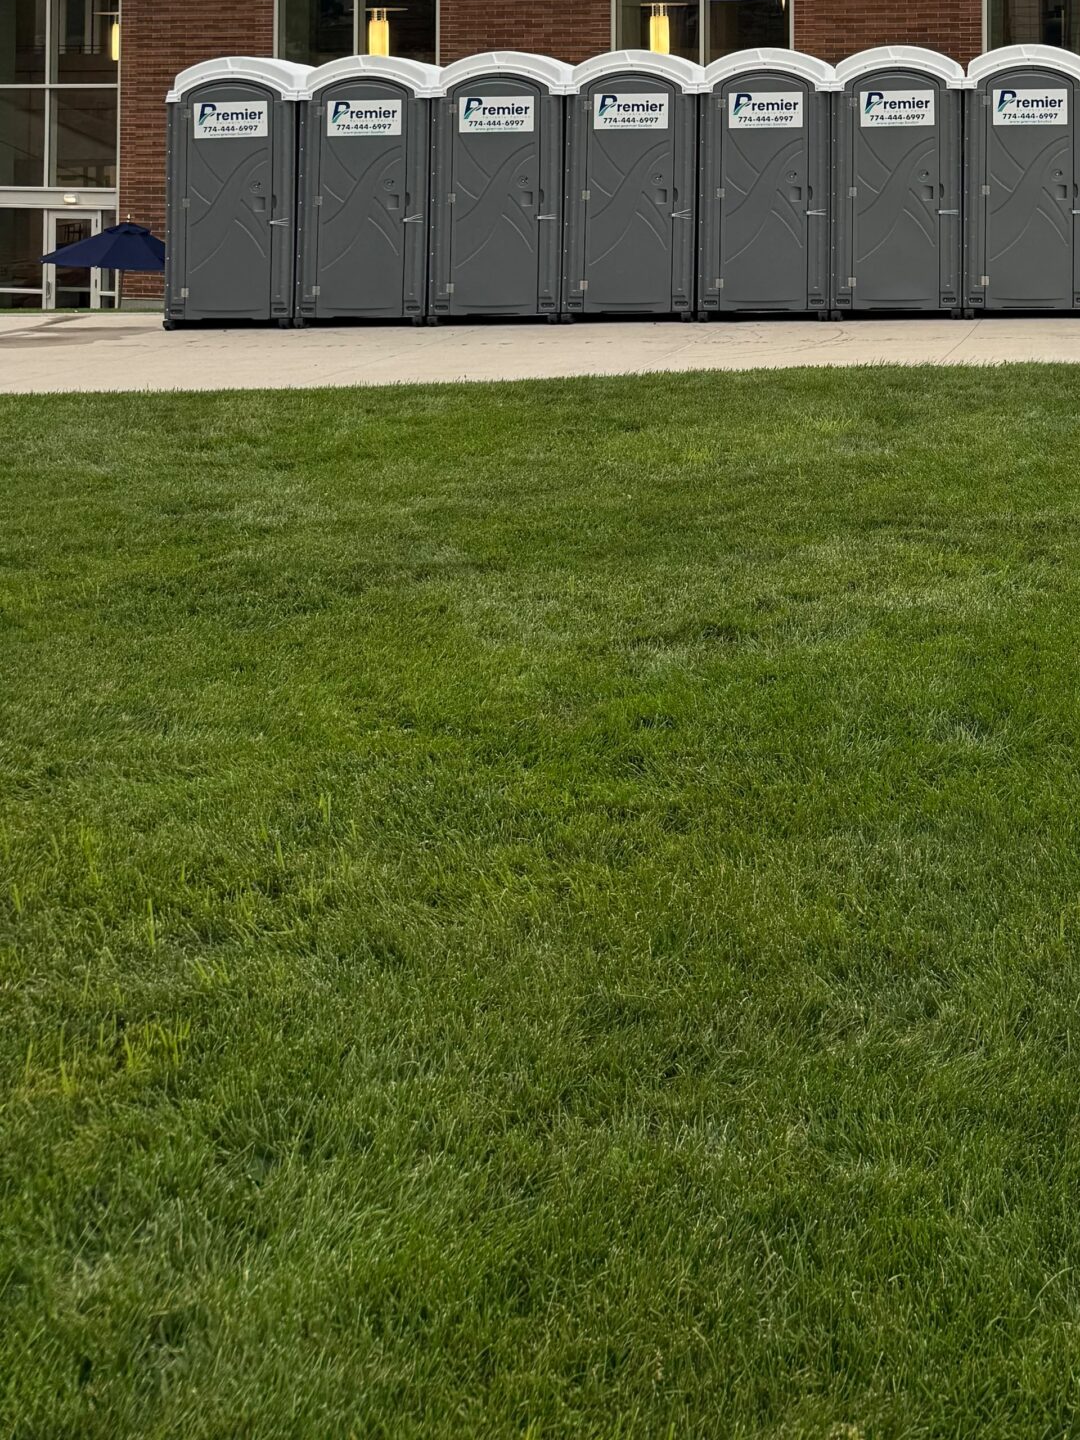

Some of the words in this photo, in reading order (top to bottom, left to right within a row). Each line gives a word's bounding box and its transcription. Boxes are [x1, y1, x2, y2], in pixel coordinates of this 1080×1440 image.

[464, 98, 529, 119] Premier
[599, 95, 664, 116] Premier
[733, 94, 798, 115] Premier
[865, 92, 930, 114] Premier
[998, 91, 1063, 112] Premier
[199, 104, 263, 125] Premier
[332, 102, 397, 123] Premier
[204, 125, 258, 133] 774-444-6997
